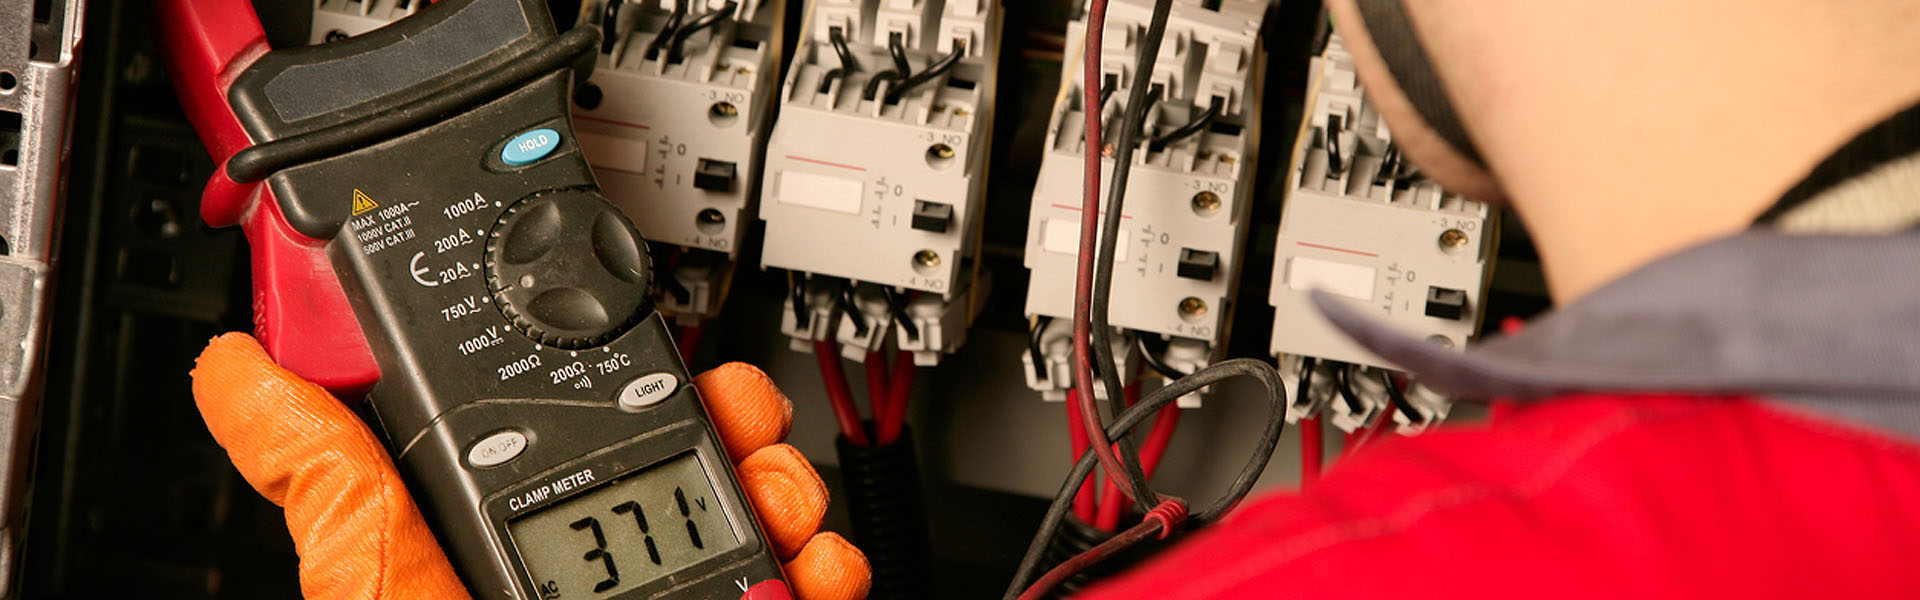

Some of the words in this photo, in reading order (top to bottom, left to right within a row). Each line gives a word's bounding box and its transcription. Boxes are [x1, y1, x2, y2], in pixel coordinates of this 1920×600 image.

[518, 134, 548, 153] HOLD
[942, 134, 962, 146] NO
[1208, 182, 1228, 194] NO
[351, 215, 376, 232] MAX
[357, 226, 384, 243] 1000V
[497, 353, 542, 381] 2000Ω
[634, 379, 665, 398] LIGHT
[509, 486, 550, 511] CLAMP
[552, 468, 595, 495] METER
[569, 486, 703, 593] 371
[695, 497, 706, 511] V
[540, 580, 559, 597] AC
